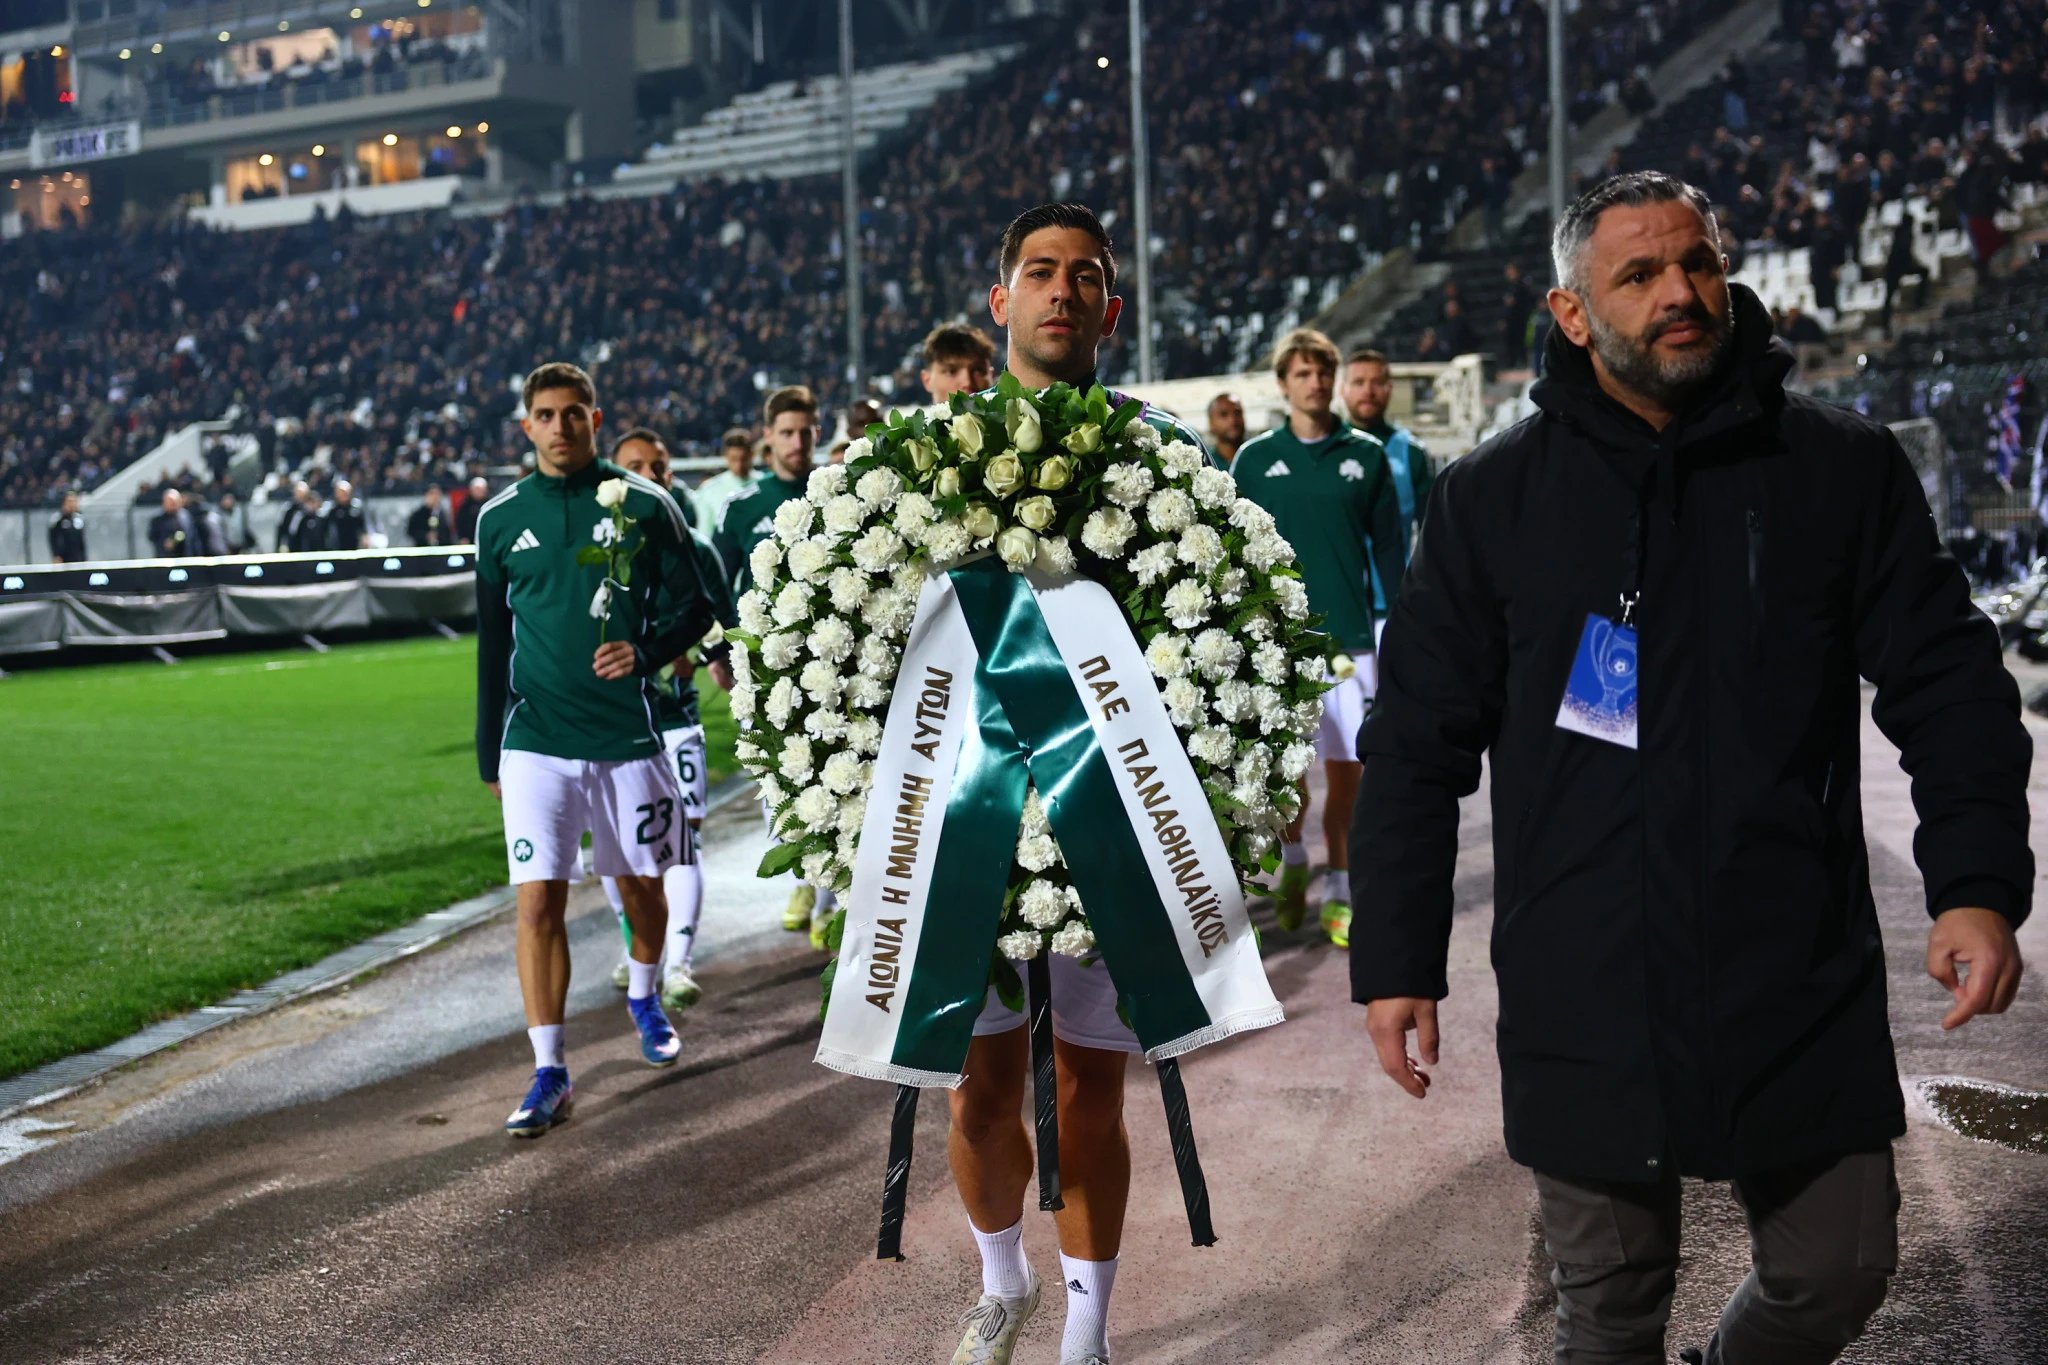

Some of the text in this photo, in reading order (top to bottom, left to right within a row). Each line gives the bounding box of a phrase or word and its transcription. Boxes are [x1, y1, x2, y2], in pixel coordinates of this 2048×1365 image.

[636, 797, 673, 845] 23
[677, 750, 696, 783] 6
[865, 666, 953, 1014] ΑΙΩΝΙΑ Η ΜΝΗΜΗ ΑΥΤΩΝ
[1078, 655, 1230, 959] ΠΑΕ ΠΑΝΑΘΗΝΑΪΚΟΣ
